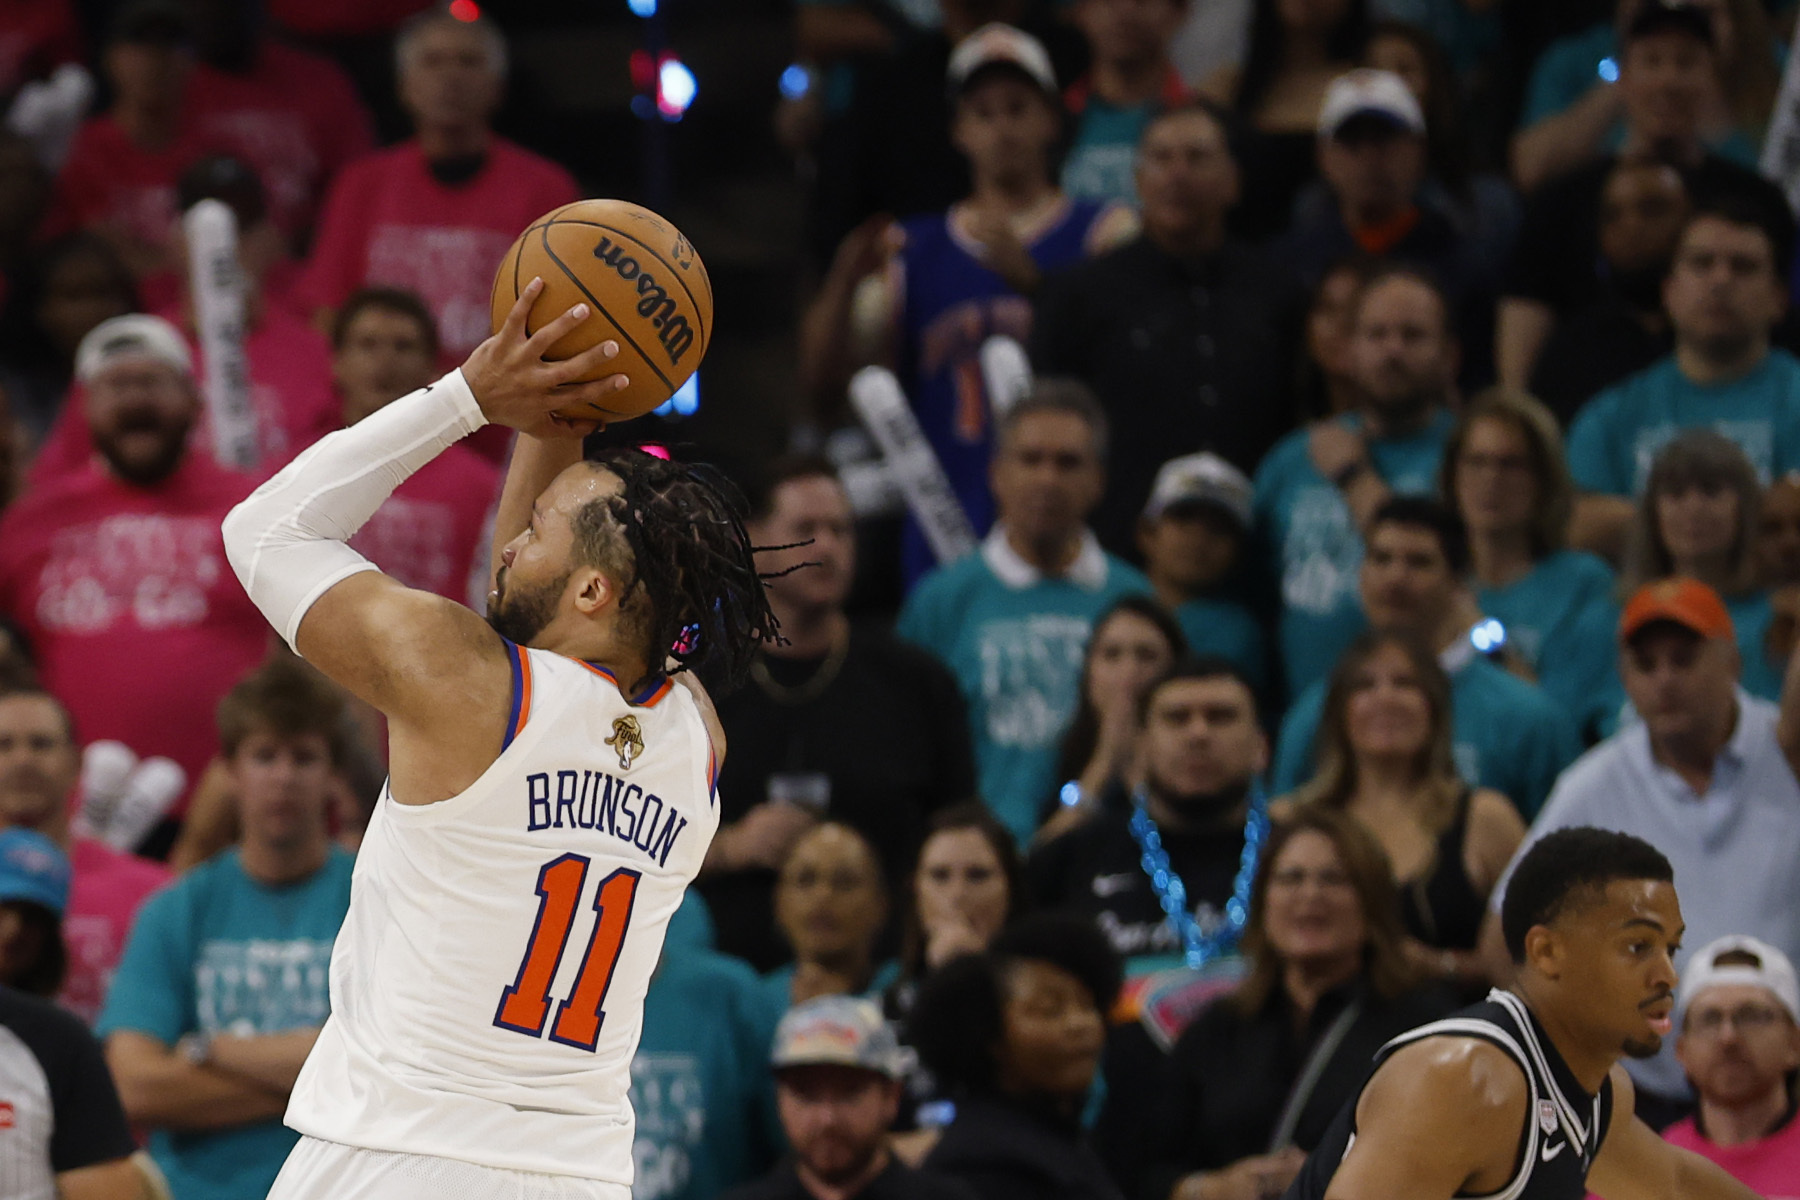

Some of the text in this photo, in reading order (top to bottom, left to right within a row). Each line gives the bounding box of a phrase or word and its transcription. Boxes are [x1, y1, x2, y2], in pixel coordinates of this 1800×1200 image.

[593, 236, 694, 366] Wilson
[526, 770, 688, 868] BRUNSON
[493, 852, 642, 1052] 11
